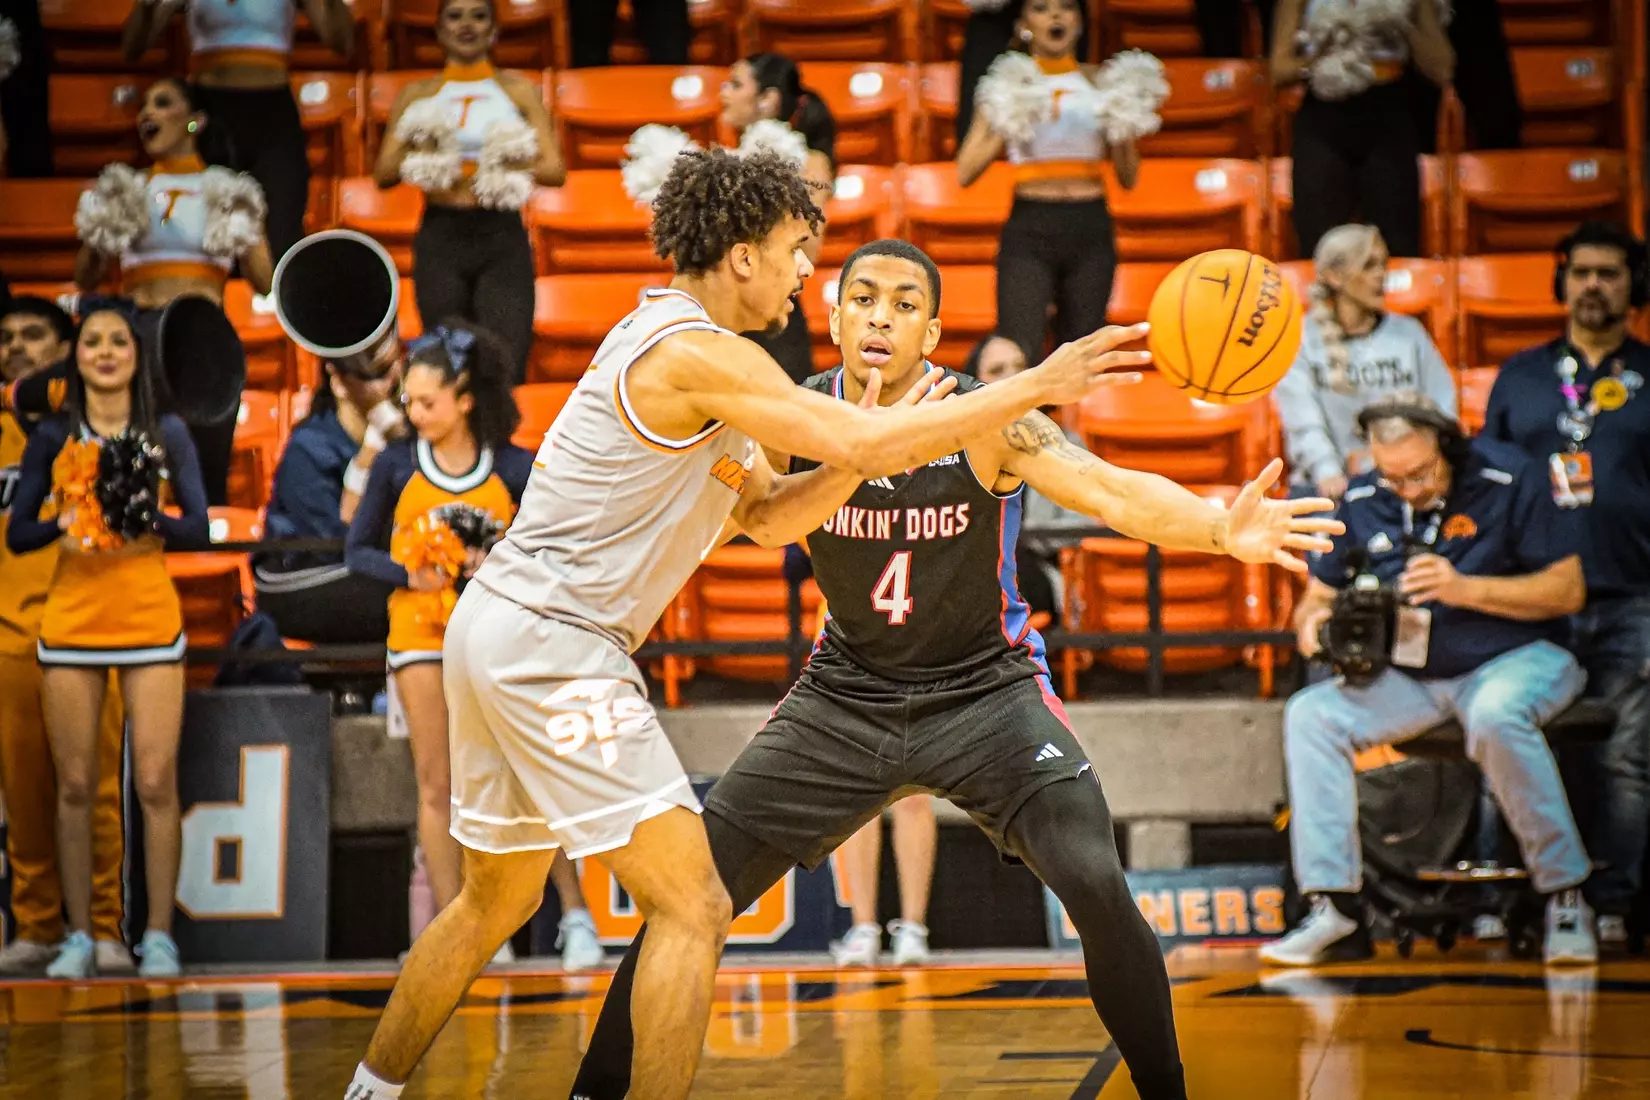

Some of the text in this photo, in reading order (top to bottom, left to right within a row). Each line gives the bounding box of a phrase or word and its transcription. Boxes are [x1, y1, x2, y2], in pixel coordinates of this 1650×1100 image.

[905, 502, 971, 541] DOGS
[870, 550, 914, 626] 4
[1061, 884, 1287, 940] NERS
